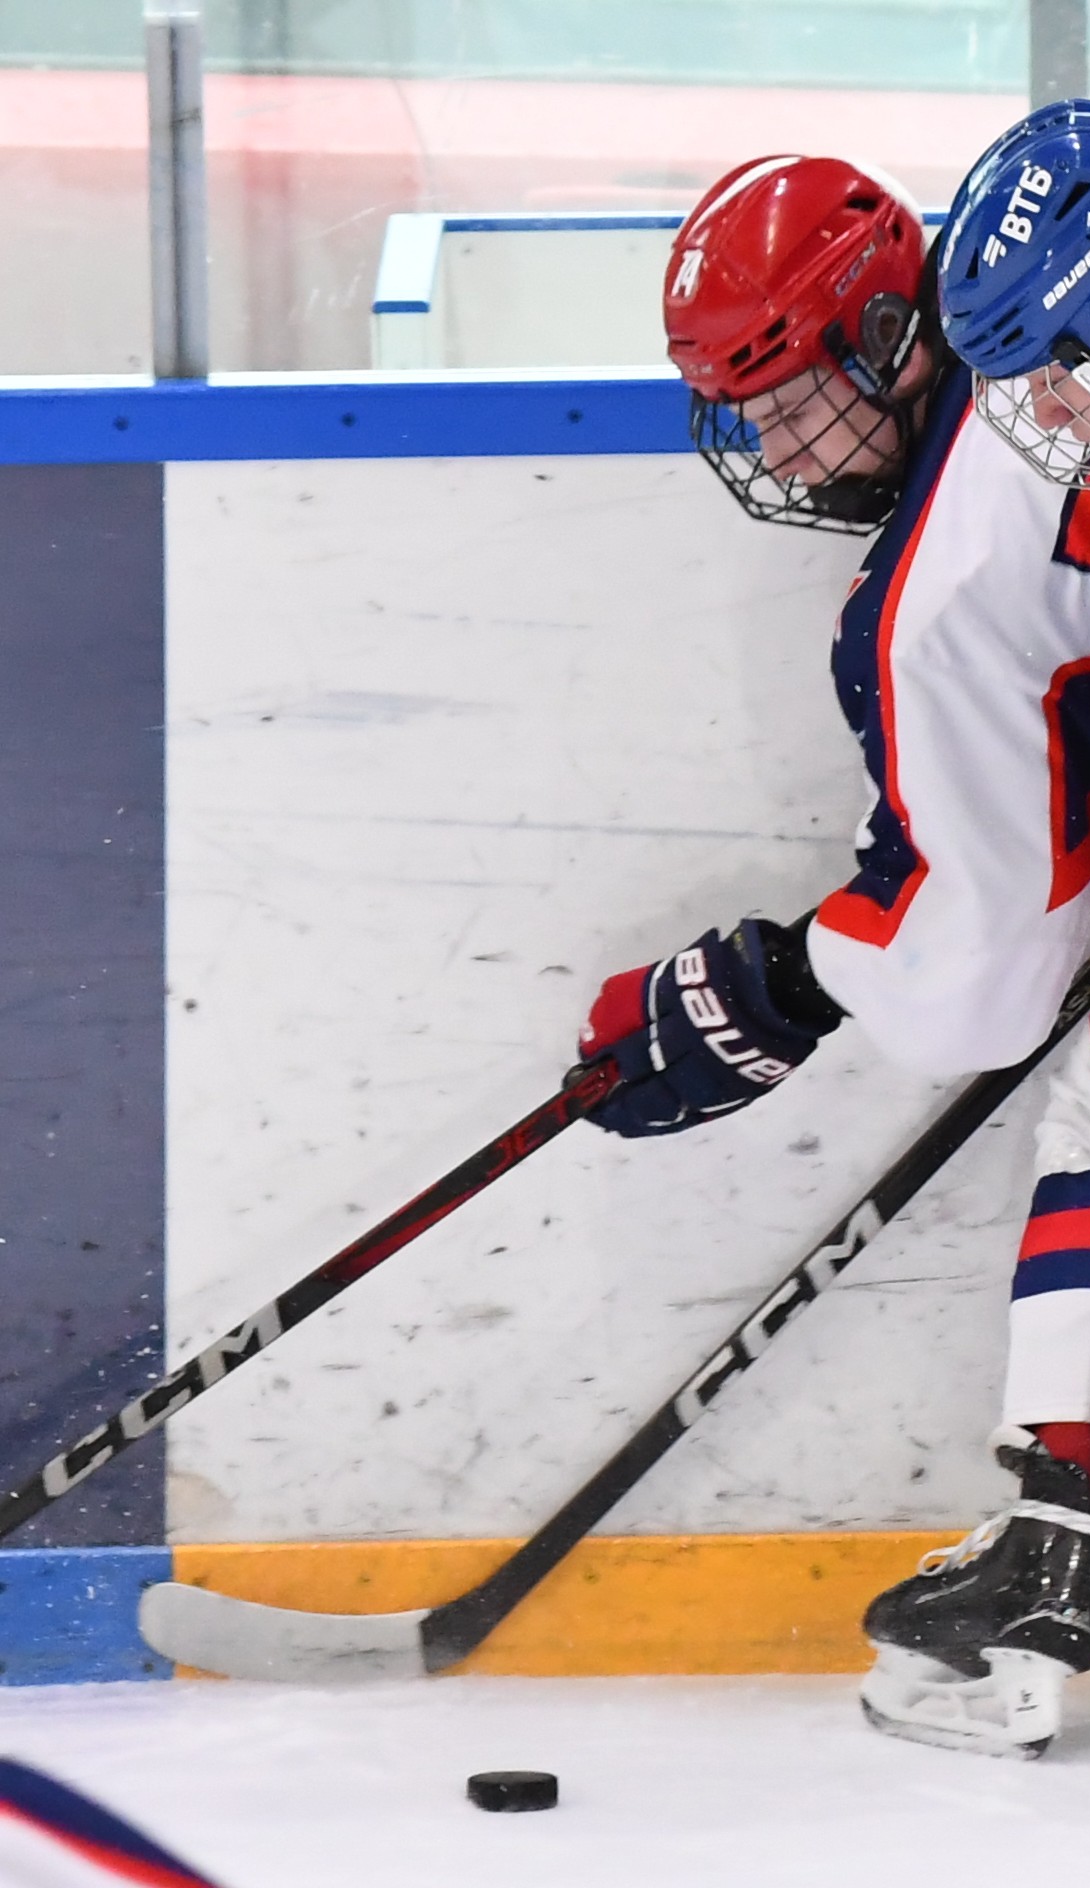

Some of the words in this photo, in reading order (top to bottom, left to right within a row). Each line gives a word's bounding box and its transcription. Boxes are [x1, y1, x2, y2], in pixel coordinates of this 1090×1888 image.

[1000, 164, 1052, 244] ВТБ
[43, 1300, 284, 1497] CCM
[676, 1199, 885, 1427] CCM
